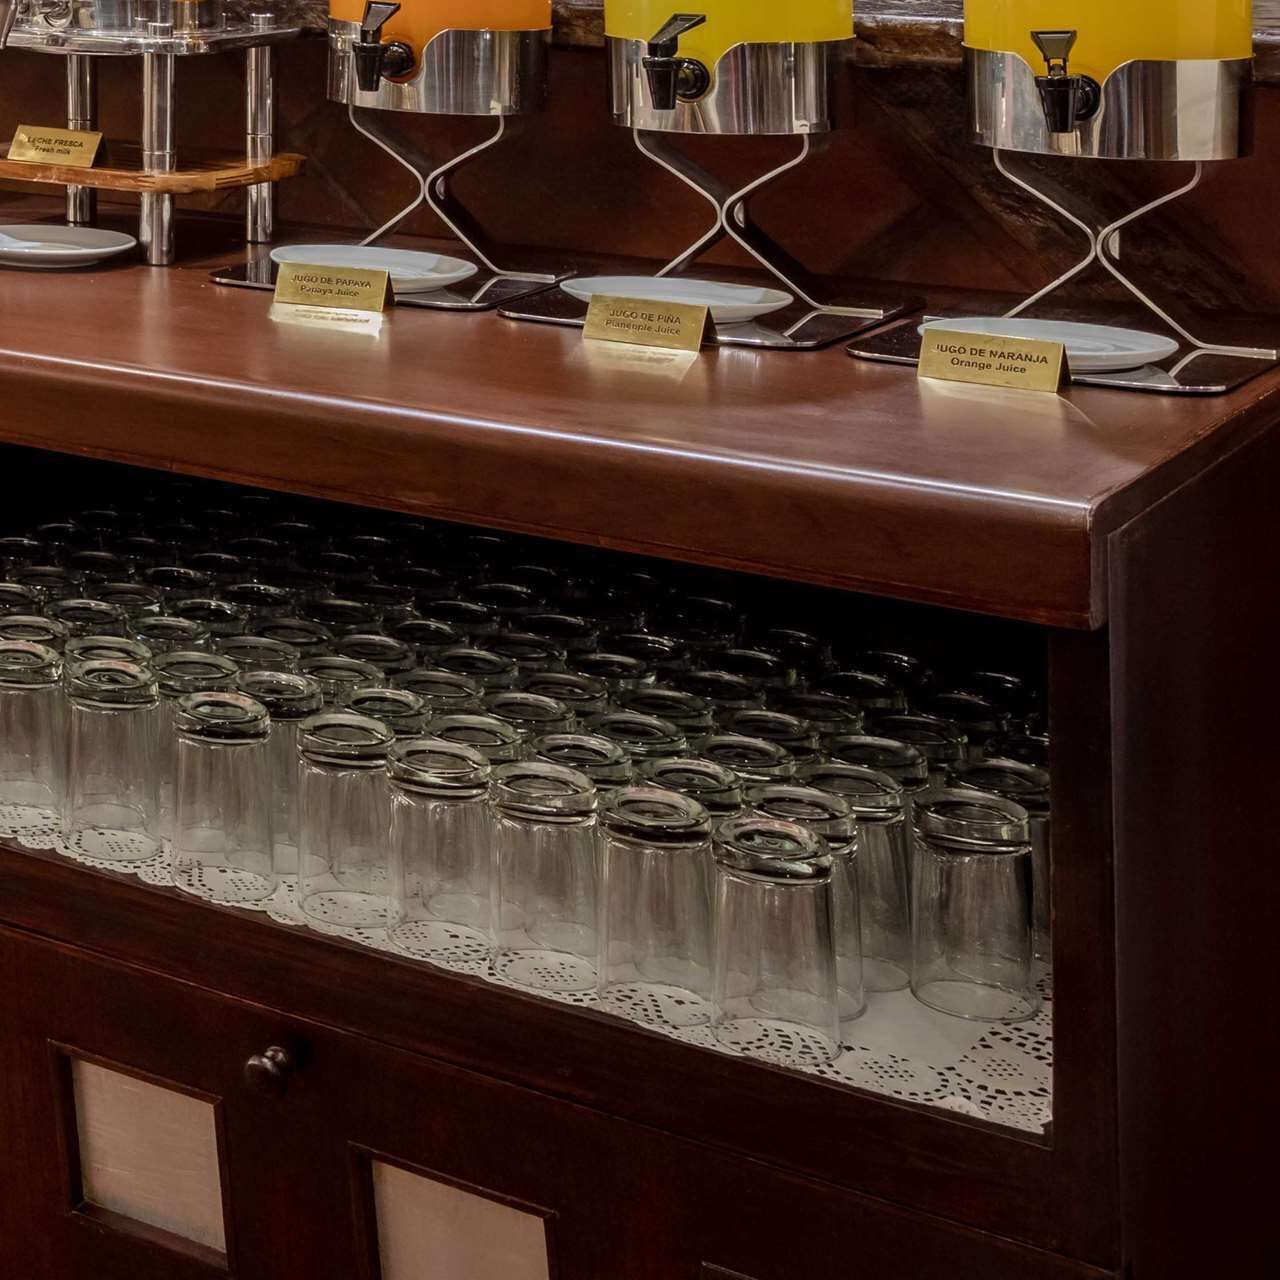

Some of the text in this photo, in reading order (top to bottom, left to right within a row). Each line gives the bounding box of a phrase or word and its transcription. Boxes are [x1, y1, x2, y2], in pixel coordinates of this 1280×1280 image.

[54, 139, 84, 148] FRESCA
[292, 274, 372, 289] JUGO DE PAPAYA
[300, 285, 360, 297] Papaya Juice
[609, 309, 682, 325] JUGO DE PIÑA
[655, 324, 681, 336] Juice
[970, 347, 988, 358] DE
[989, 349, 1049, 365] NARANJA
[951, 357, 1027, 374] Orange Juice
